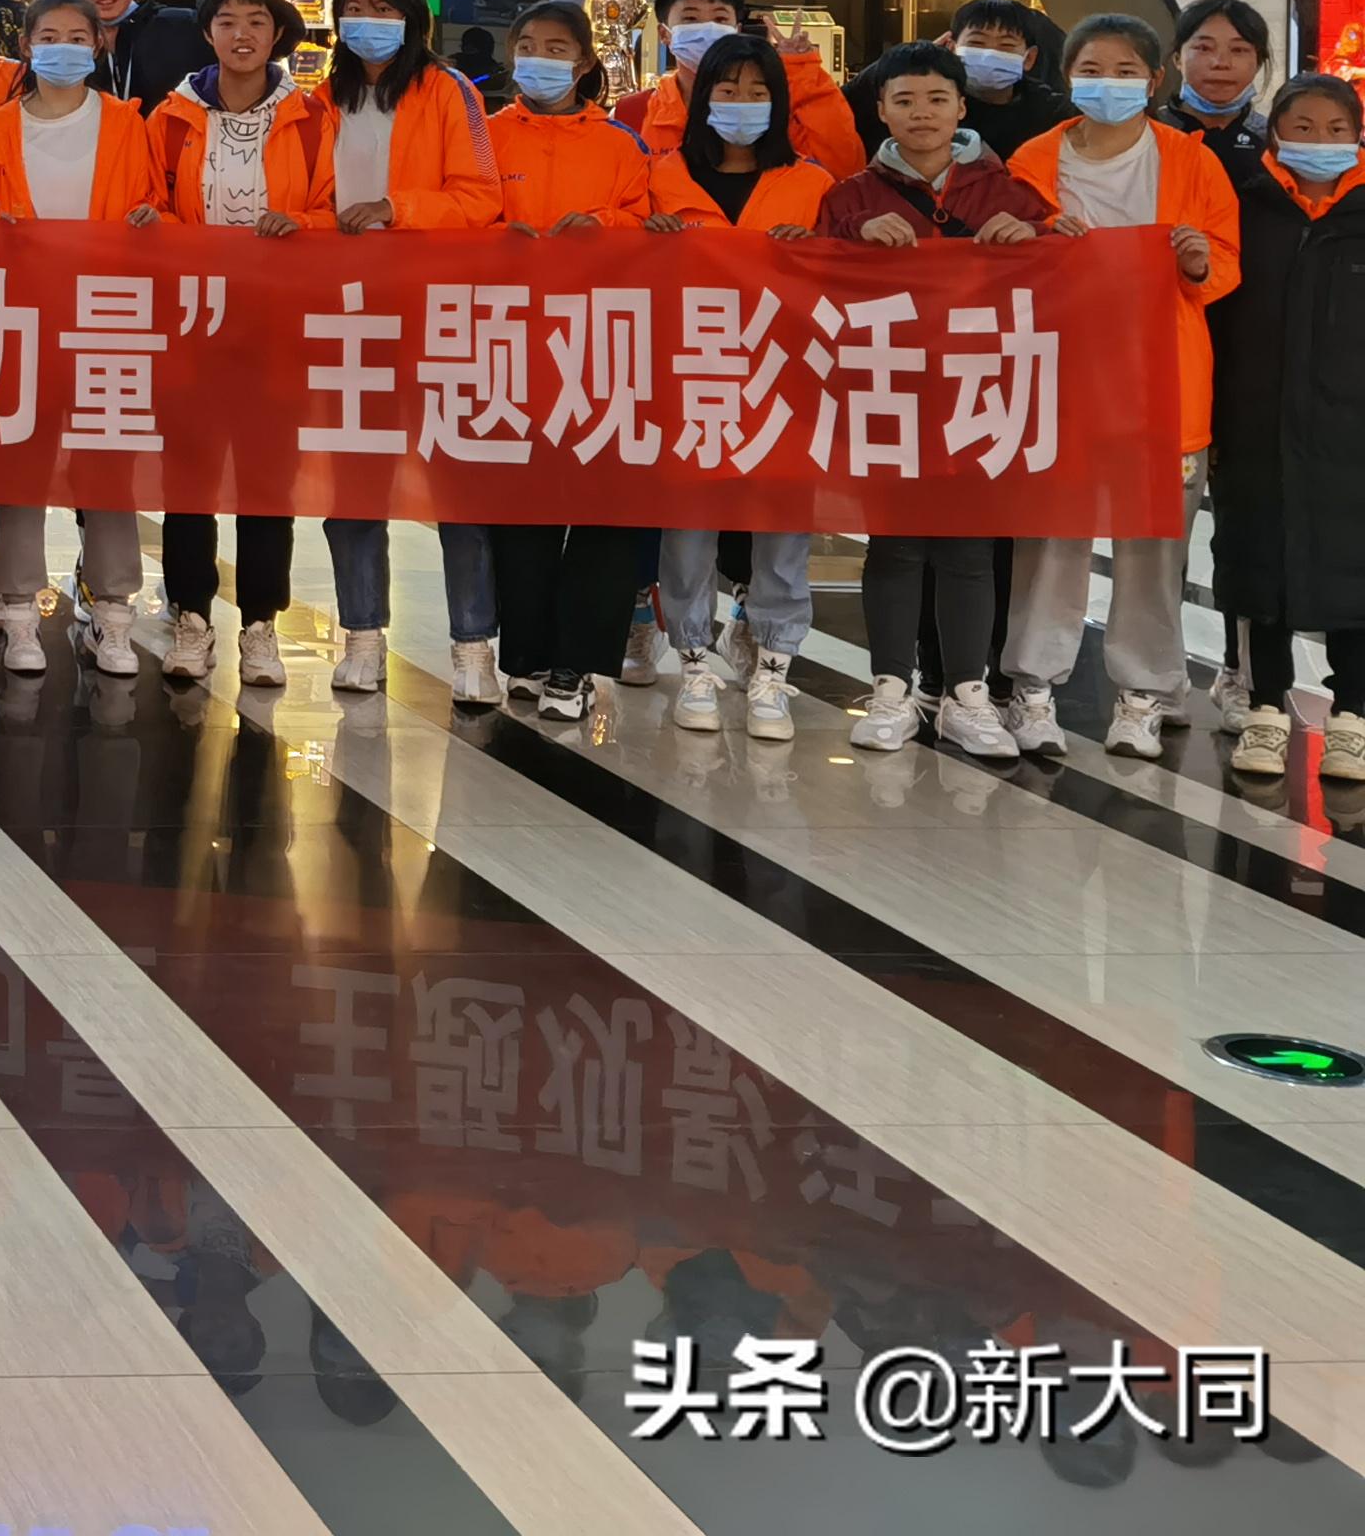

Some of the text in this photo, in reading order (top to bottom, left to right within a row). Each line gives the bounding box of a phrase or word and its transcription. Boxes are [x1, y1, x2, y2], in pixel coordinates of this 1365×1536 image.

[297, 280, 1060, 479] 主题观影活动
